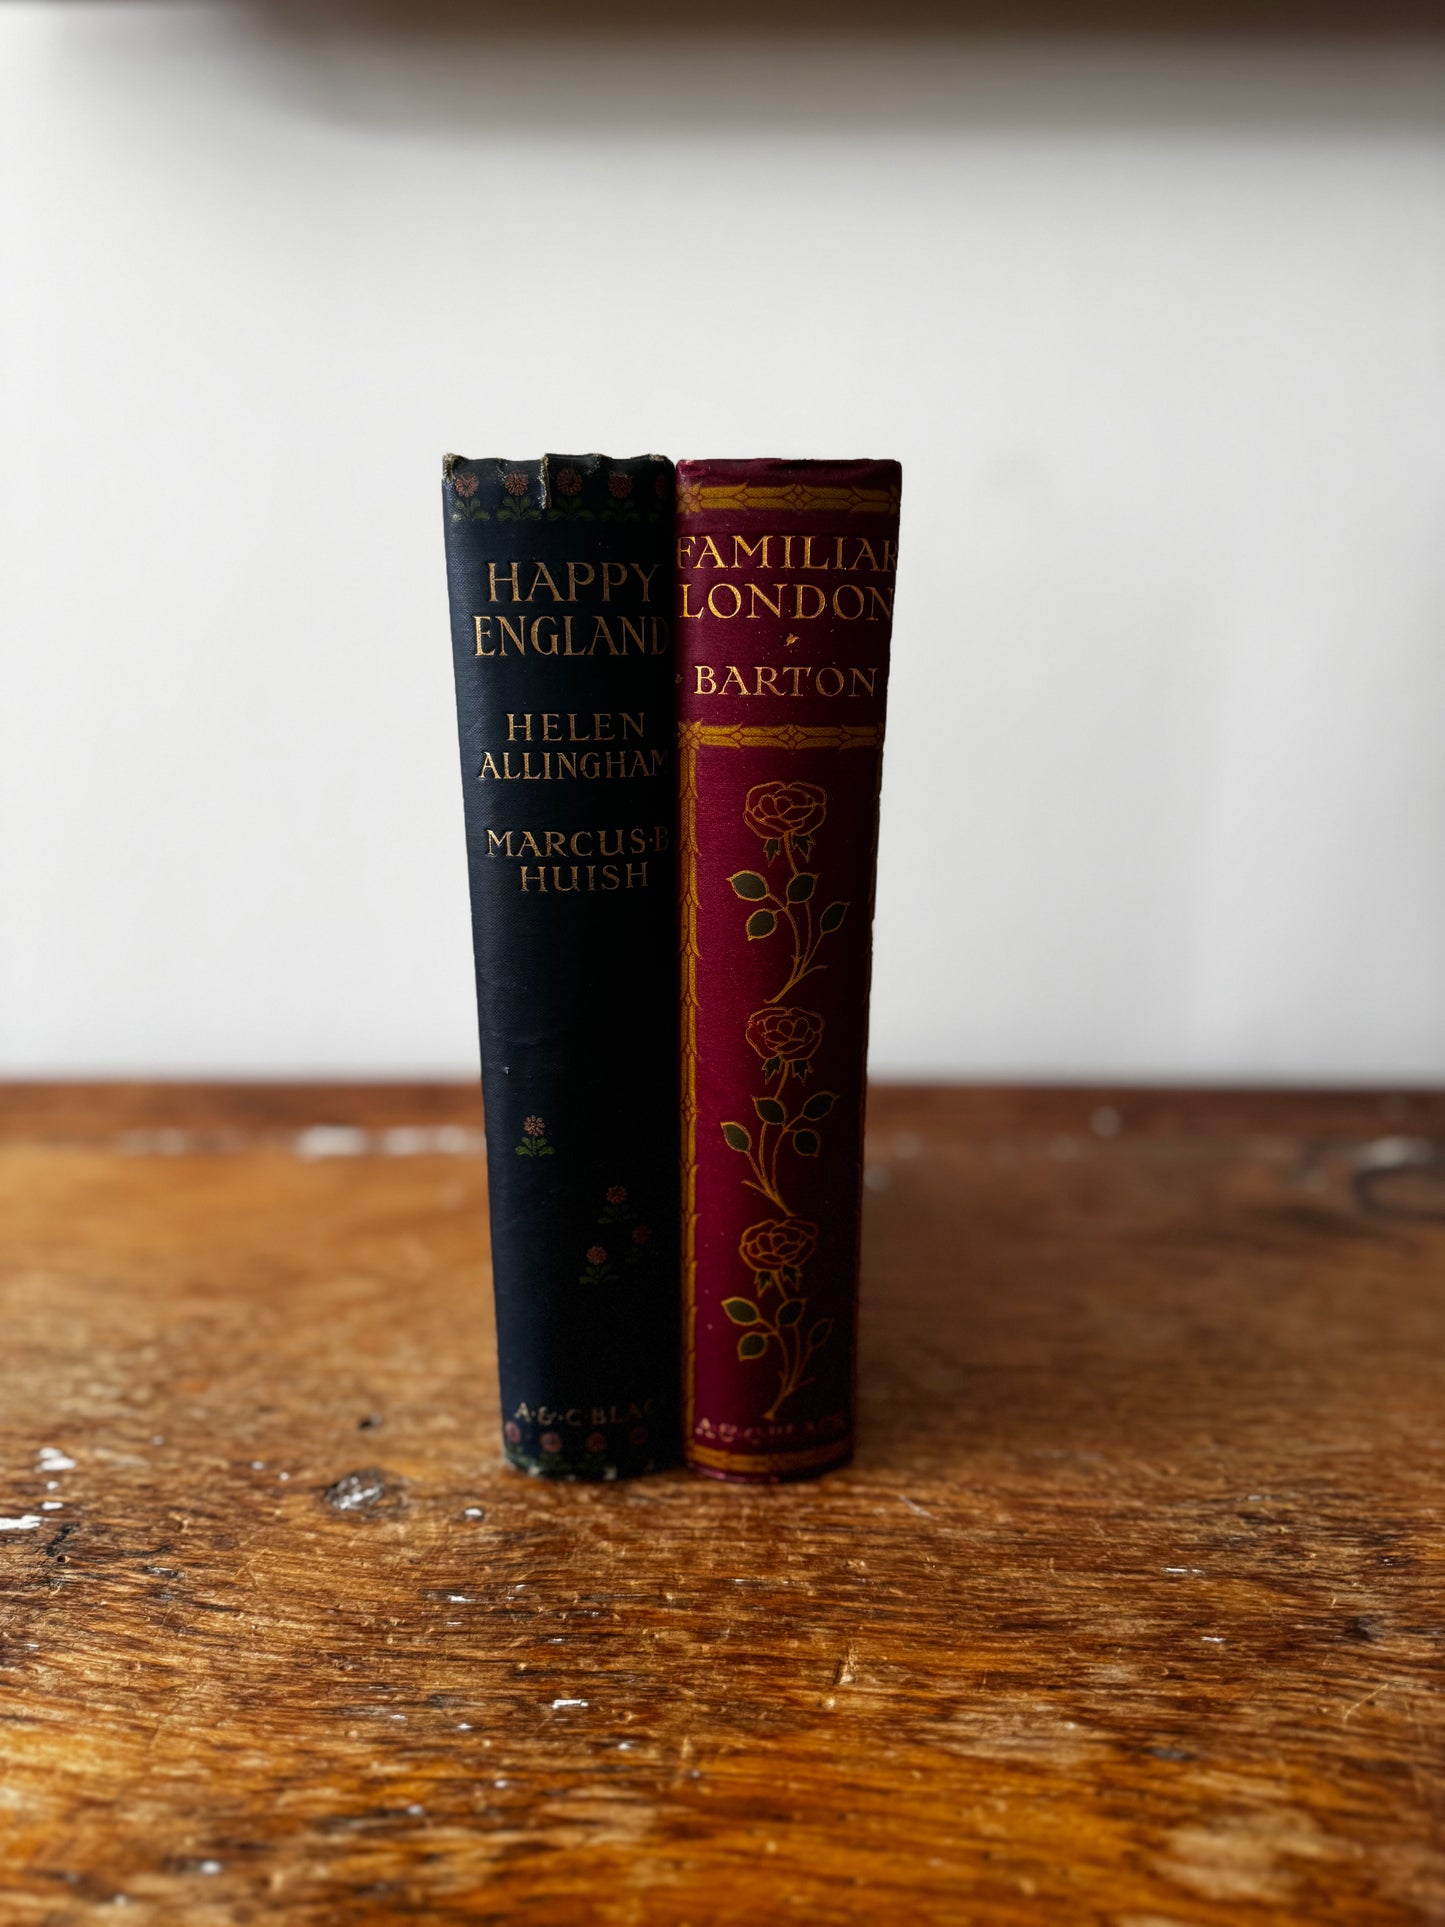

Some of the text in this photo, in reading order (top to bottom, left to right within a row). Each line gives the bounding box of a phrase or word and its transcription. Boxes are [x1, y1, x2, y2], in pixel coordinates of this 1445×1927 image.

[487, 562, 663, 603] HAPPY
[678, 583, 894, 621] LONDON
[472, 615, 669, 656] ENGLAND
[693, 665, 879, 697] BARTON
[506, 712, 645, 742] HELEN
[478, 749, 672, 780] ALLINGHAM
[519, 861, 648, 893] HUISH
